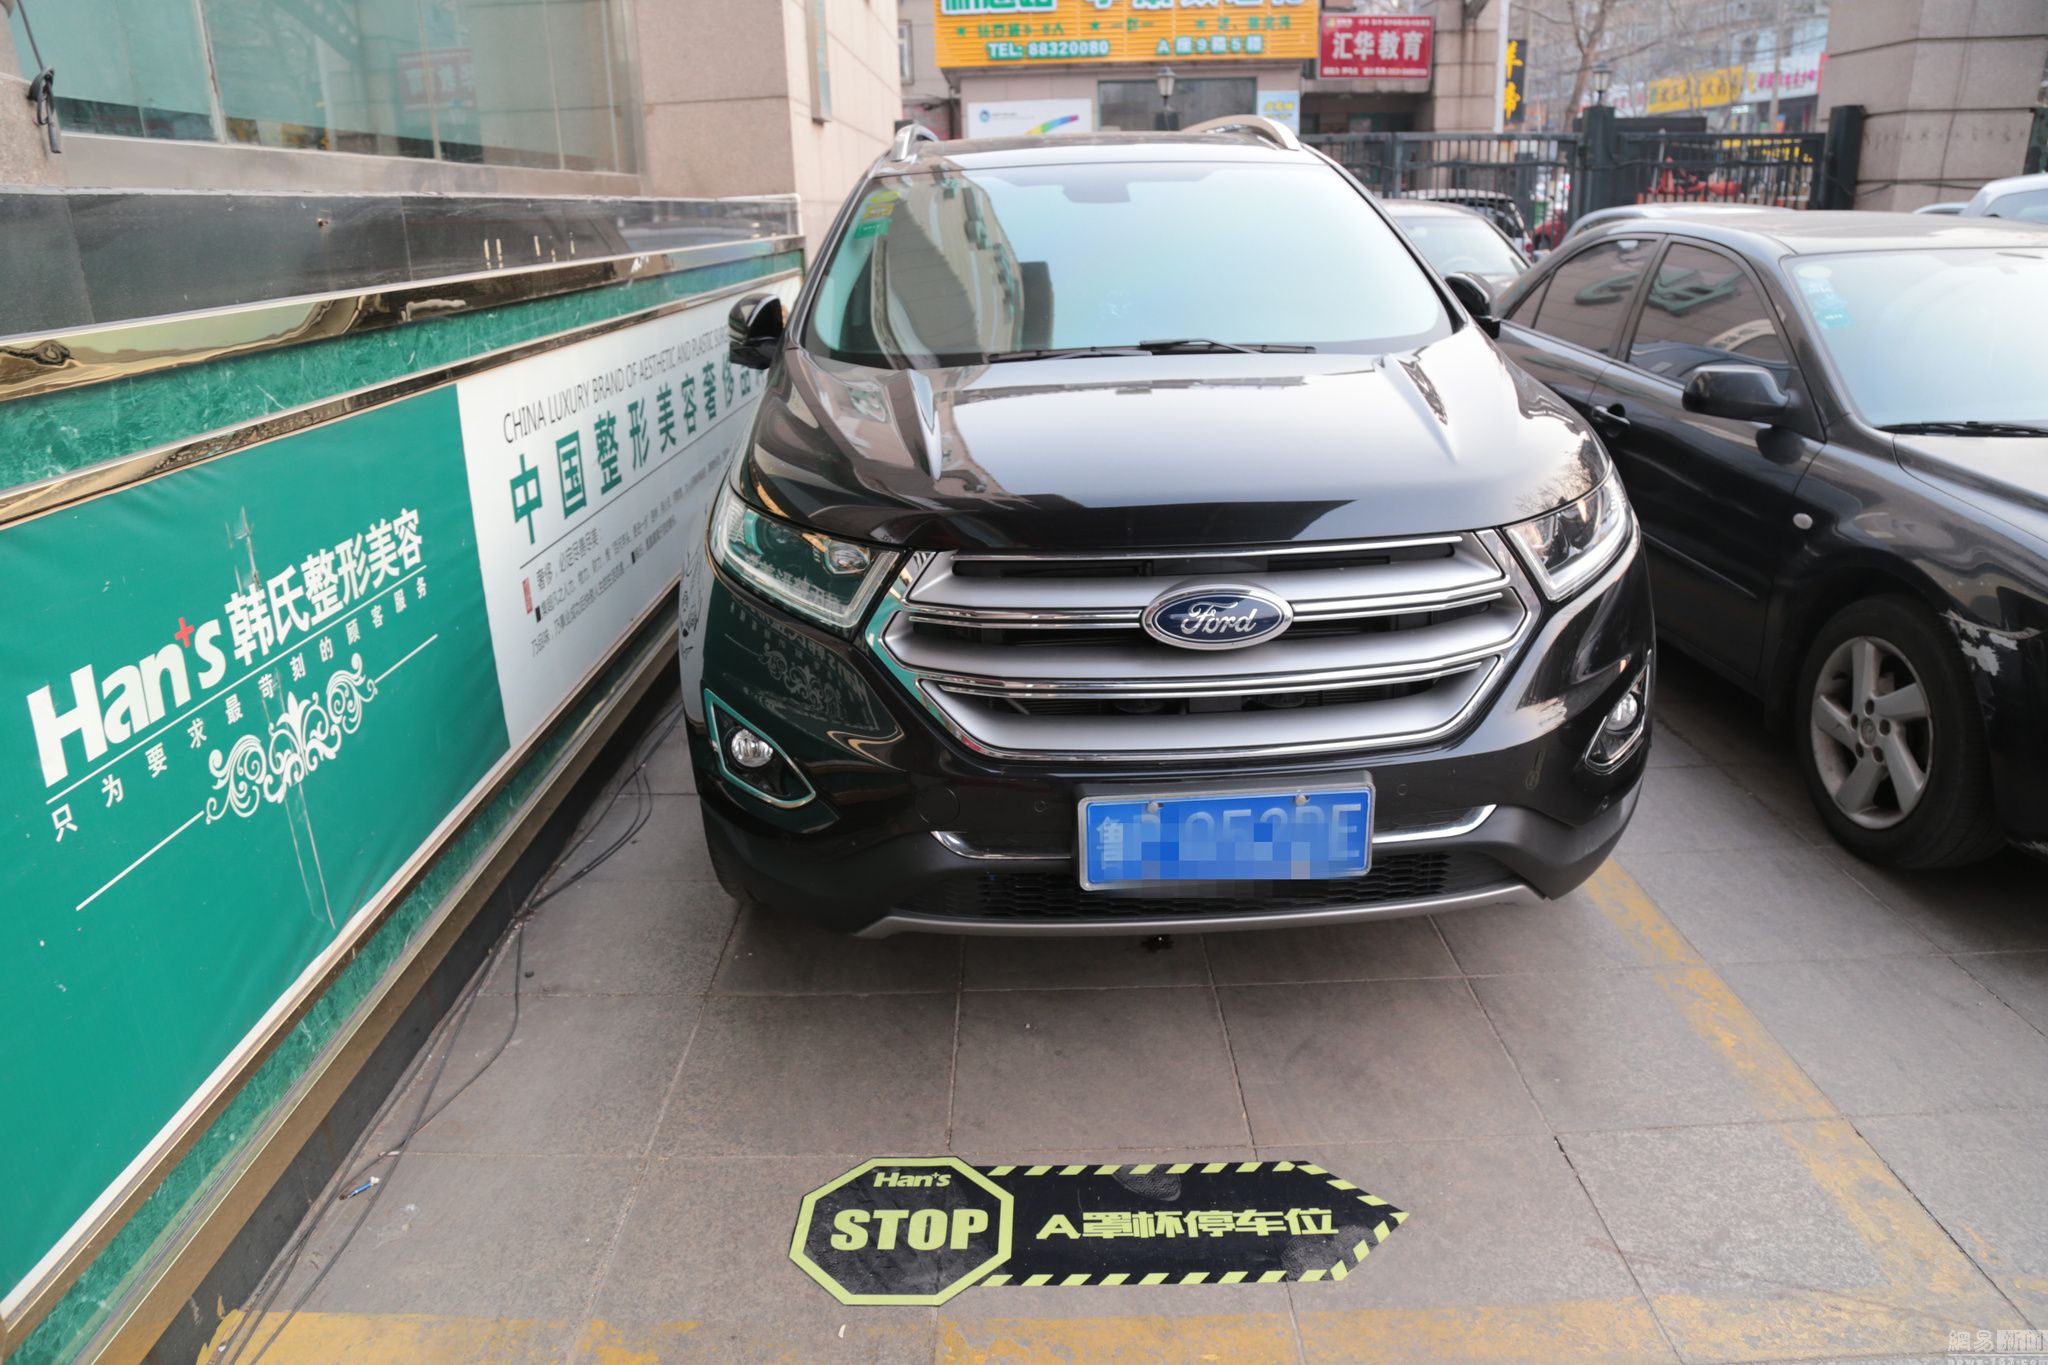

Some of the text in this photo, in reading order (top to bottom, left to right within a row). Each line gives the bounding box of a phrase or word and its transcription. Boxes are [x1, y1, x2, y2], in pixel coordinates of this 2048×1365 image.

[988, 41, 1109, 58] TEL: 88320080
[1332, 31, 1423, 61] 汇华教育
[503, 401, 547, 443] CHINA
[547, 383, 591, 424] LUXURY
[592, 367, 625, 403] BRAND
[627, 362, 637, 388] OF
[639, 347, 676, 381] AESTHETIC
[677, 341, 690, 364] AND
[691, 332, 714, 357] PLASTIC
[1180, 601, 1257, 635] Ford
[27, 617, 227, 788] Han's
[225, 508, 424, 666] 韩氏整形美容
[52, 576, 429, 842] 只为要求最苛刻的顾客服务
[874, 1171, 952, 1188] Han's
[831, 1208, 989, 1251] STOP
[1036, 1208, 1338, 1239] A罩杯停车位
